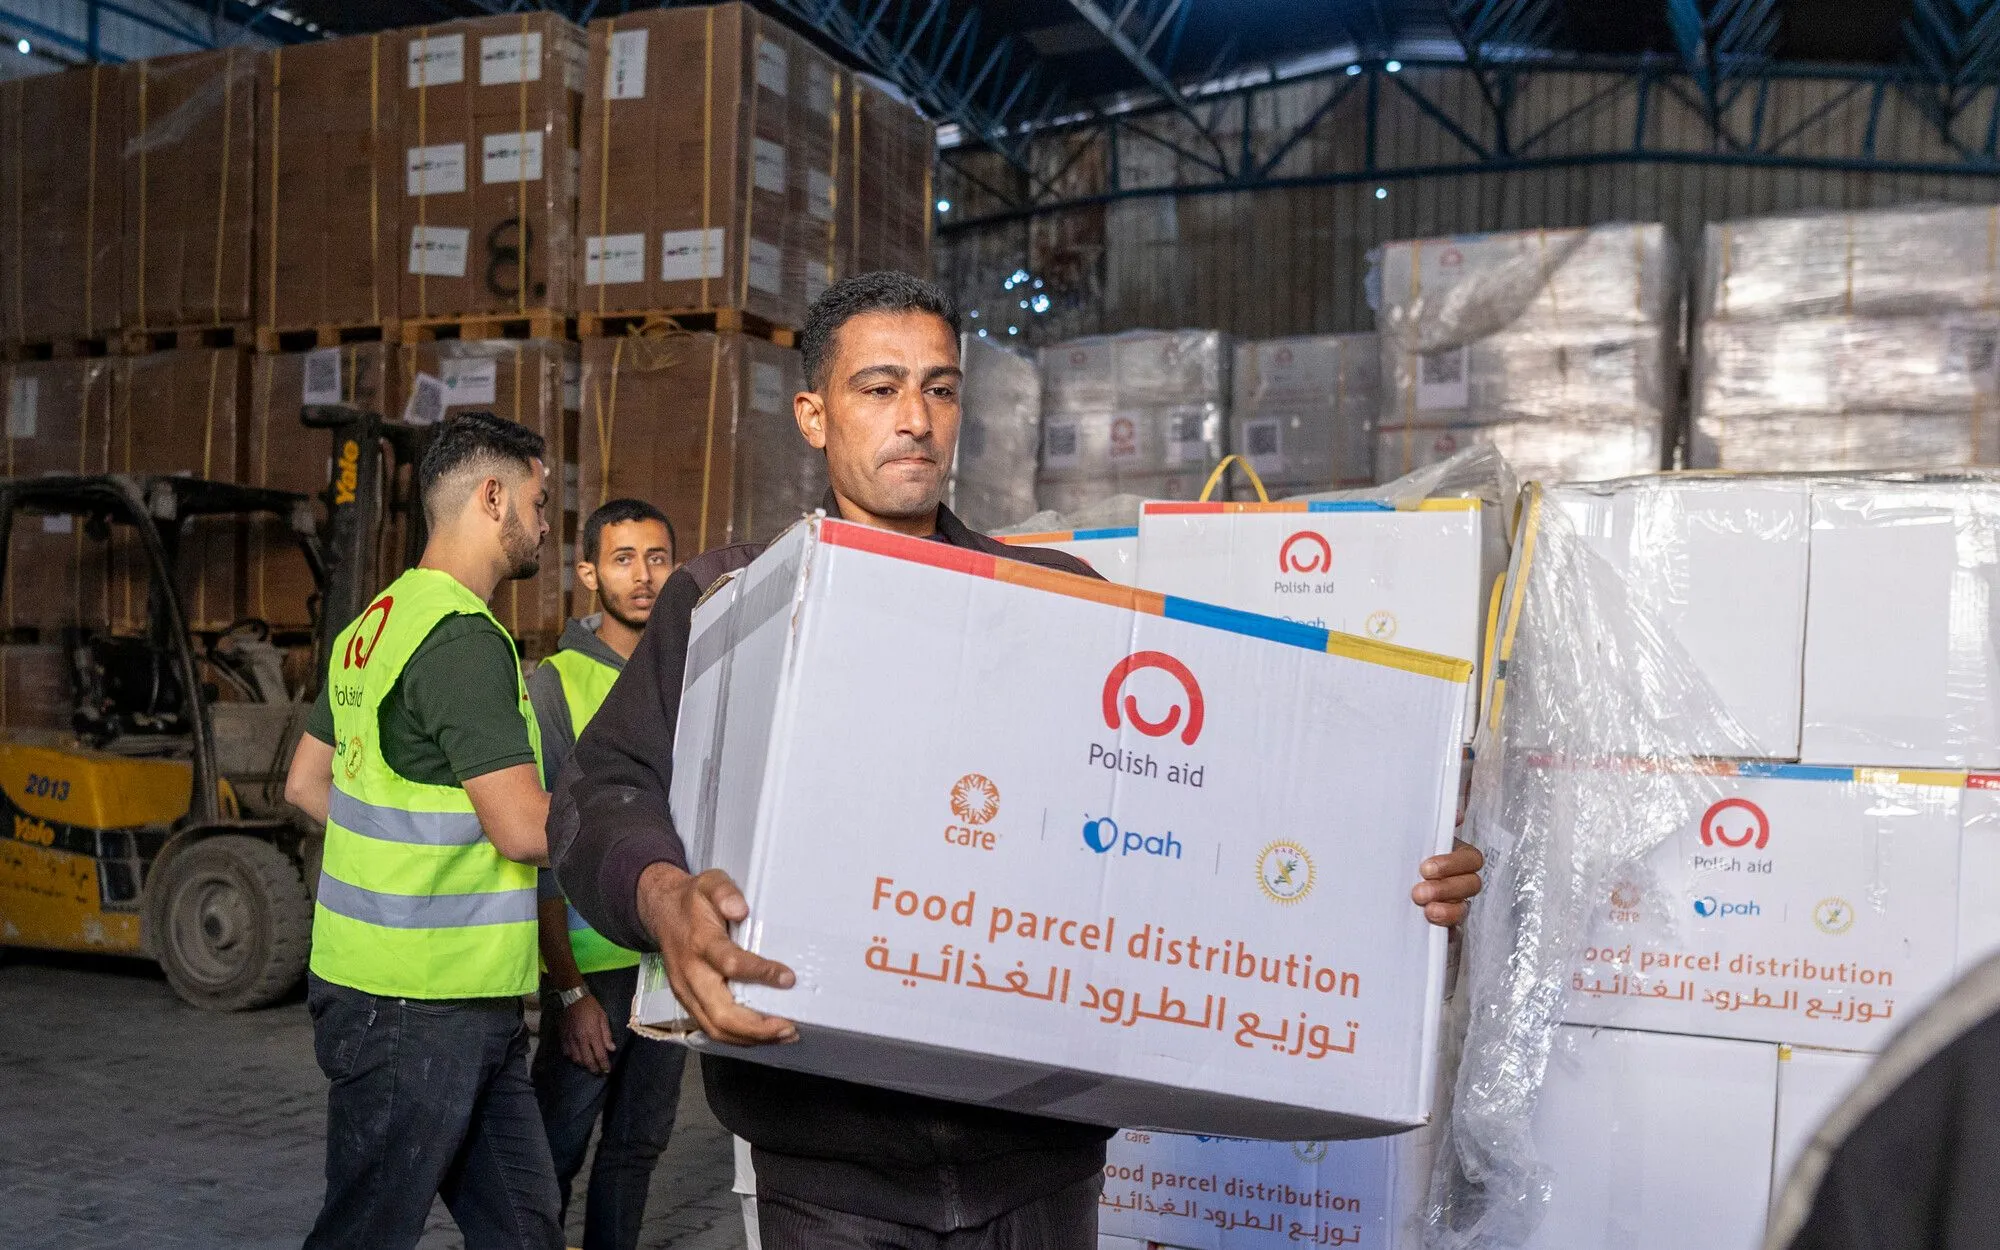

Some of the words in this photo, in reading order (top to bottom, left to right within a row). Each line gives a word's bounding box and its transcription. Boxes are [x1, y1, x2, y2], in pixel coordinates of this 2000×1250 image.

[336, 440, 359, 505] Yale
[1274, 581, 1311, 594] Polish
[1315, 582, 1335, 594] aid
[1088, 742, 1158, 779] Polish
[1167, 762, 1204, 788] aid
[25, 774, 71, 801] 2013
[14, 815, 56, 847] Yale
[944, 825, 996, 851] care
[1121, 831, 1182, 859] pah
[1747, 859, 1772, 874] aid
[1609, 910, 1640, 922] care
[1721, 900, 1760, 917] pah
[872, 876, 976, 928] Food
[988, 906, 1115, 953] parcel
[1127, 923, 1360, 998] distribution
[864, 935, 1070, 1004] الغذائية
[1584, 944, 1631, 964] ood
[1640, 951, 1720, 972] parcel
[1729, 955, 1893, 987] distribution
[1080, 983, 1226, 1033] الطرود
[1702, 987, 1798, 1012] الطرود
[1806, 997, 1894, 1023] توزيع
[1234, 1011, 1359, 1060] توزيع
[1125, 1131, 1150, 1144] care
[1105, 1164, 1144, 1182] ood
[1152, 1171, 1217, 1193] parcel
[1224, 1177, 1361, 1213] distribution
[1204, 1208, 1283, 1231] الطرود
[1289, 1221, 1362, 1246] توزيع
